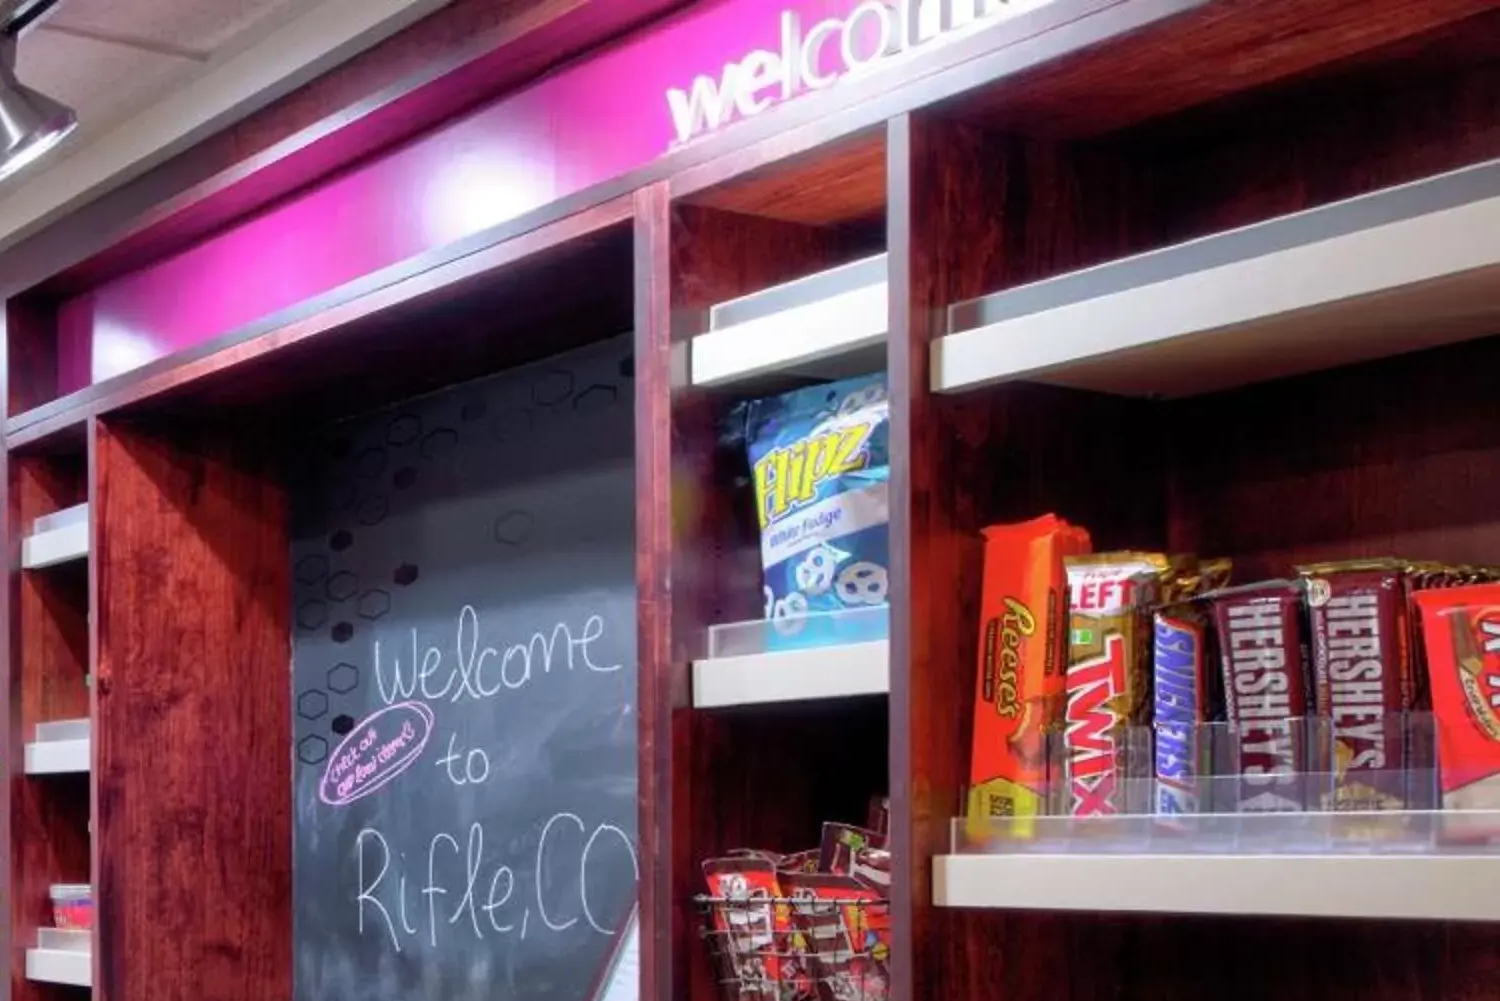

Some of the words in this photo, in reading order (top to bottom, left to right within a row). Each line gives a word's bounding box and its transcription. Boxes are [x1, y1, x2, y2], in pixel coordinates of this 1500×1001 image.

[374, 604, 623, 705] Welcome
[995, 596, 1036, 720] Reese's
[1065, 630, 1127, 818] TWIX
[1227, 597, 1296, 786] HERSHEY'S
[1326, 593, 1386, 769] HERSHEY'S
[435, 732, 490, 785] to
